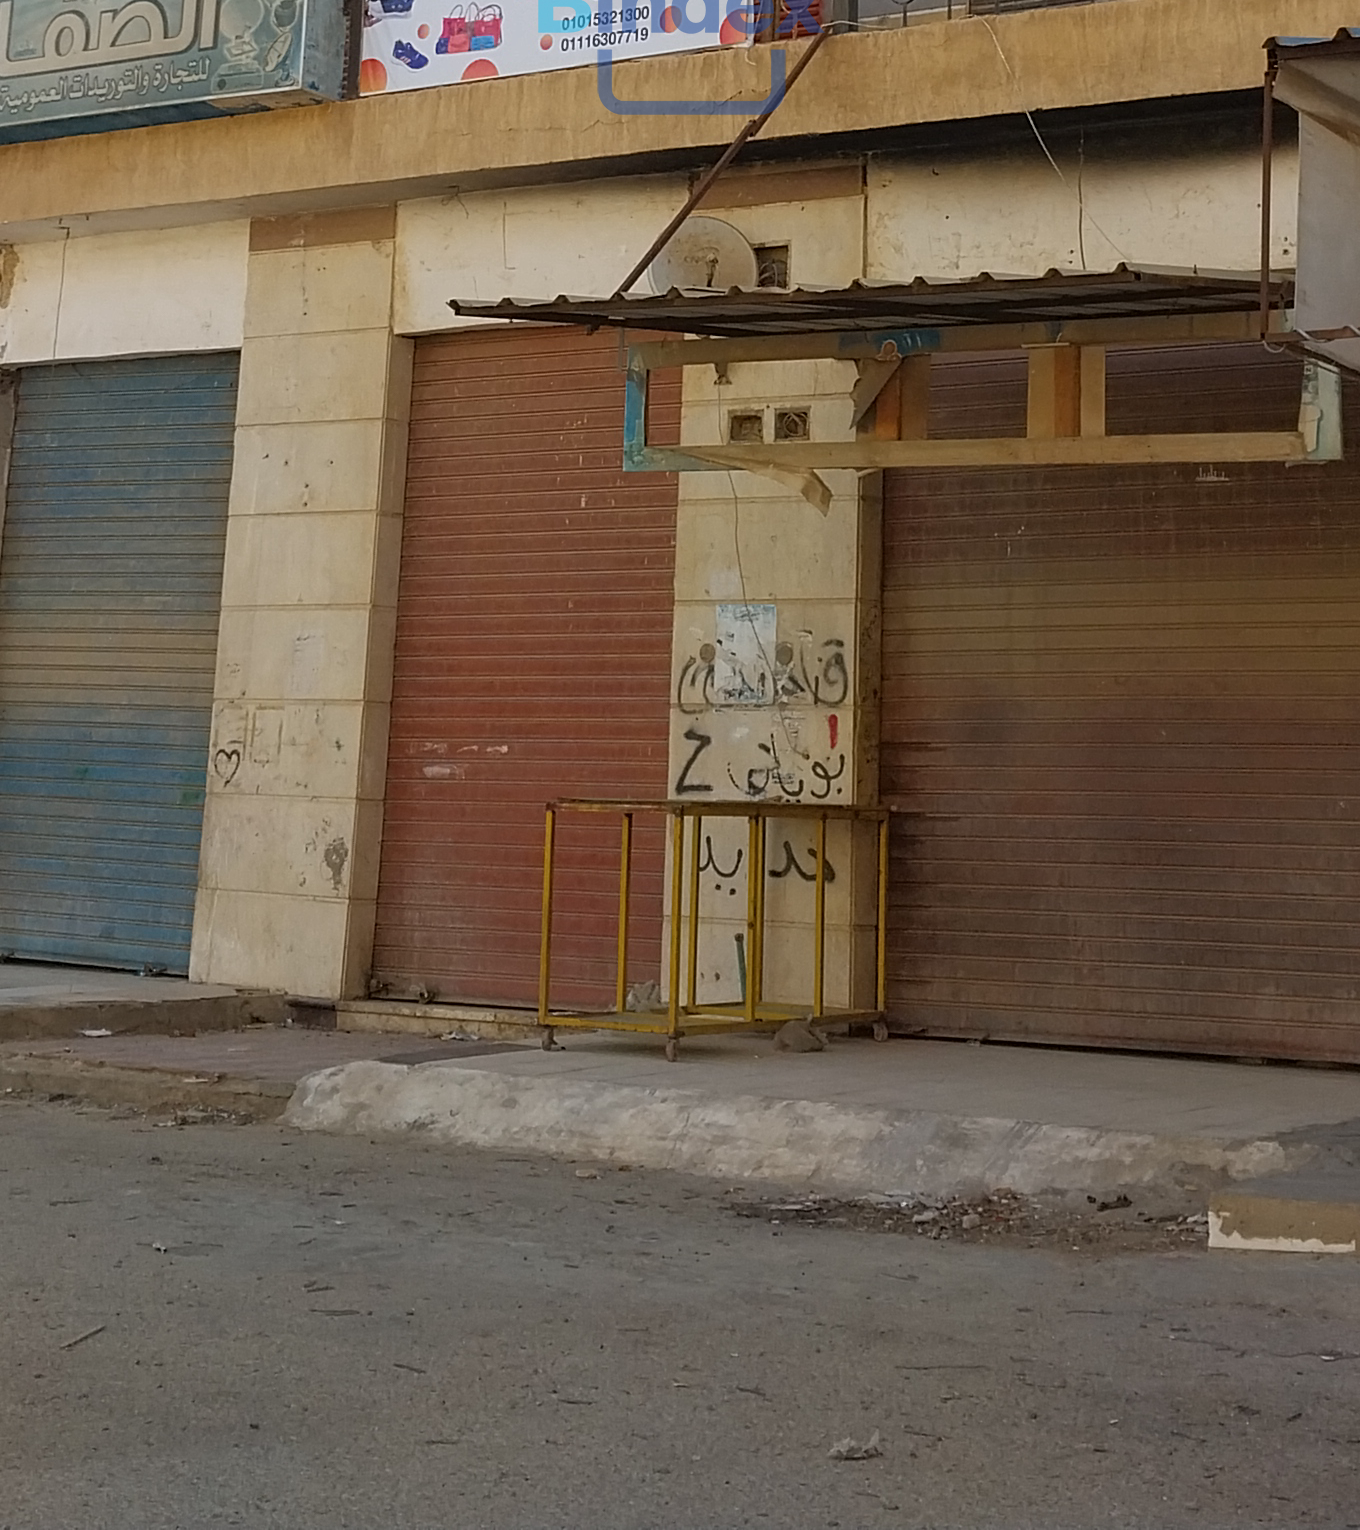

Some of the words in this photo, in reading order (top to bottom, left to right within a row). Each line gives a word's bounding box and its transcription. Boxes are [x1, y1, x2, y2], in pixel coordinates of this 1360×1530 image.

[561, 6, 650, 31] 01015321300
[561, 28, 649, 52] 01116307719
[70, 67, 149, 102] والتوريدات
[152, 58, 210, 93] للتجارة
[0, 80, 67, 115] العمومية
